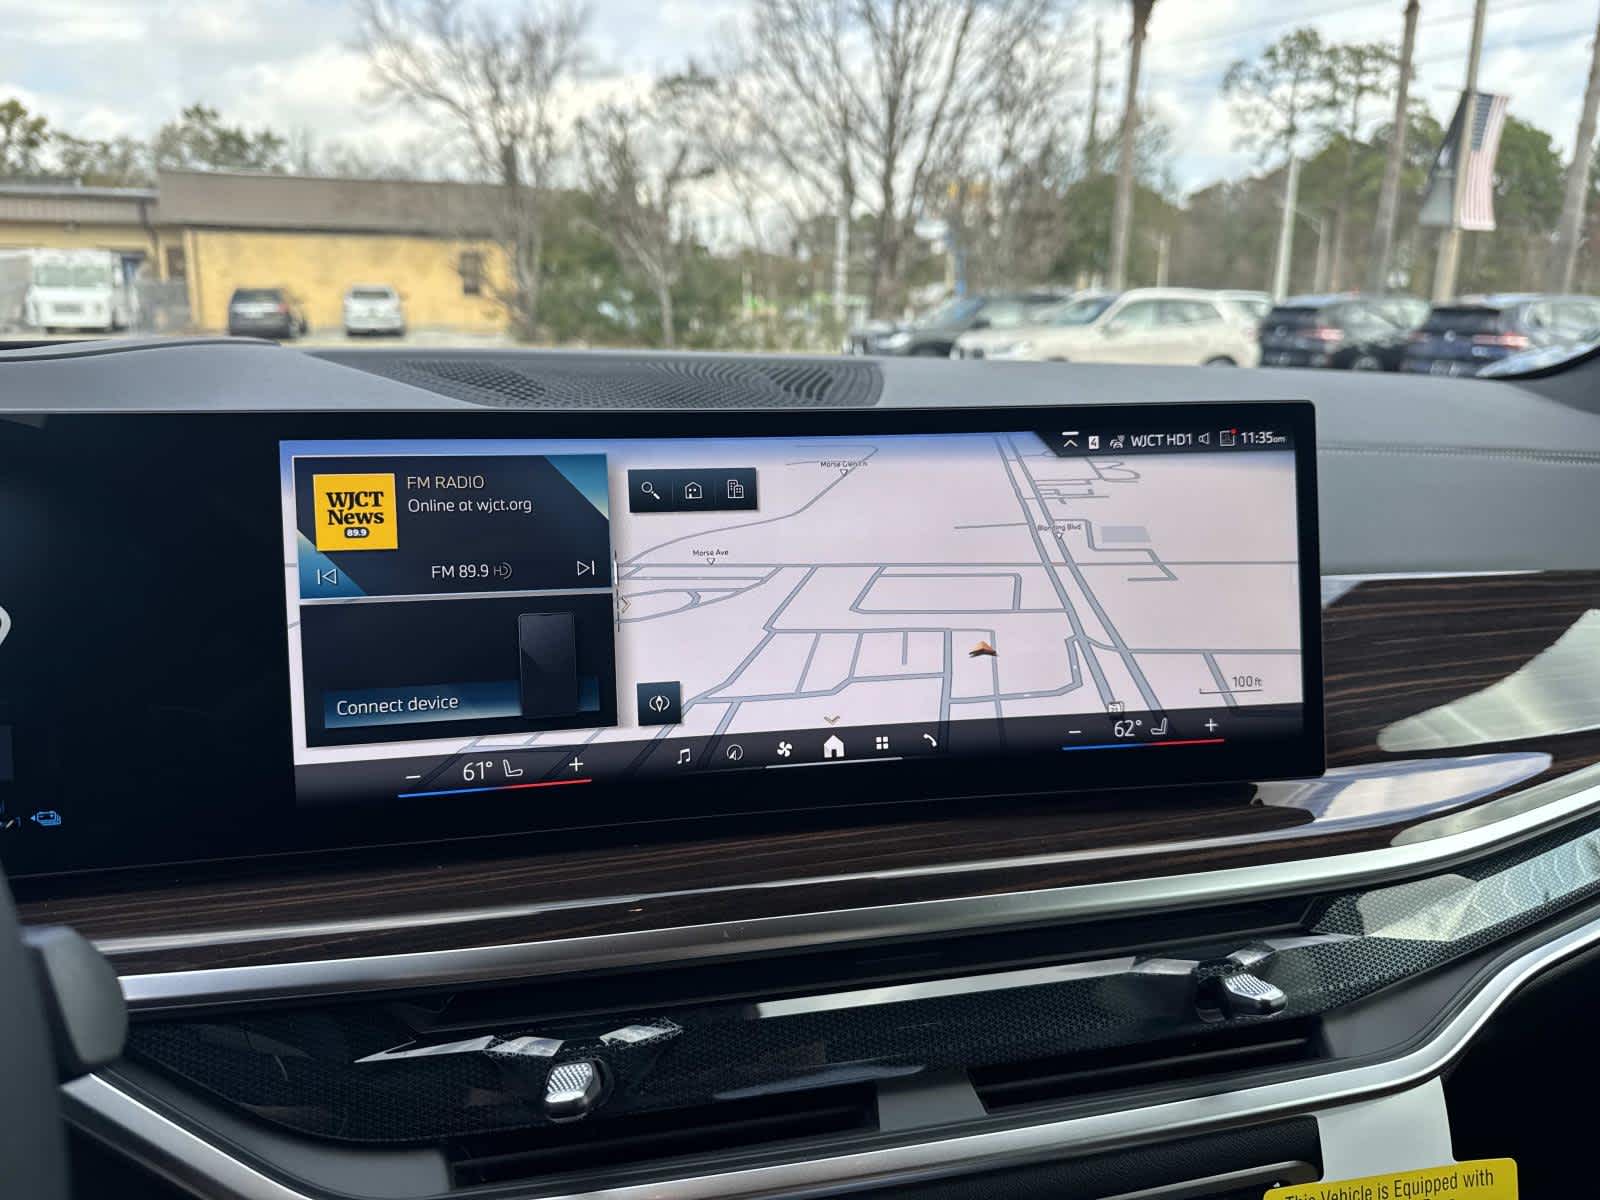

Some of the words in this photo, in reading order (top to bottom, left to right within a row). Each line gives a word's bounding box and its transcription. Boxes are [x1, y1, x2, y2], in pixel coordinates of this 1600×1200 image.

[1089, 436, 1099, 449] 4
[1130, 434, 1164, 448] WJCT
[1166, 433, 1192, 446] HD1
[1241, 431, 1286, 444] 11:35am
[407, 476, 431, 489] FM
[435, 475, 485, 489] RADIO
[326, 491, 384, 510] WJCT
[407, 498, 455, 513] Online
[458, 498, 474, 512] at
[476, 498, 532, 513] wjct.org
[327, 509, 385, 526] News
[346, 528, 368, 537] 89.9
[431, 565, 455, 579] FM
[458, 563, 489, 578] 89.9
[1232, 675, 1253, 688] 100
[1254, 677, 1263, 687] ft
[336, 699, 404, 716] Connect
[407, 696, 459, 711] device
[1114, 719, 1142, 737] 62°
[463, 760, 493, 781] 61°
[1320, 1185, 1373, 1200] Vehicle
[1377, 1182, 1390, 1200] is
[1394, 1175, 1458, 1198] Equipped
[1463, 1169, 1494, 1187] with
